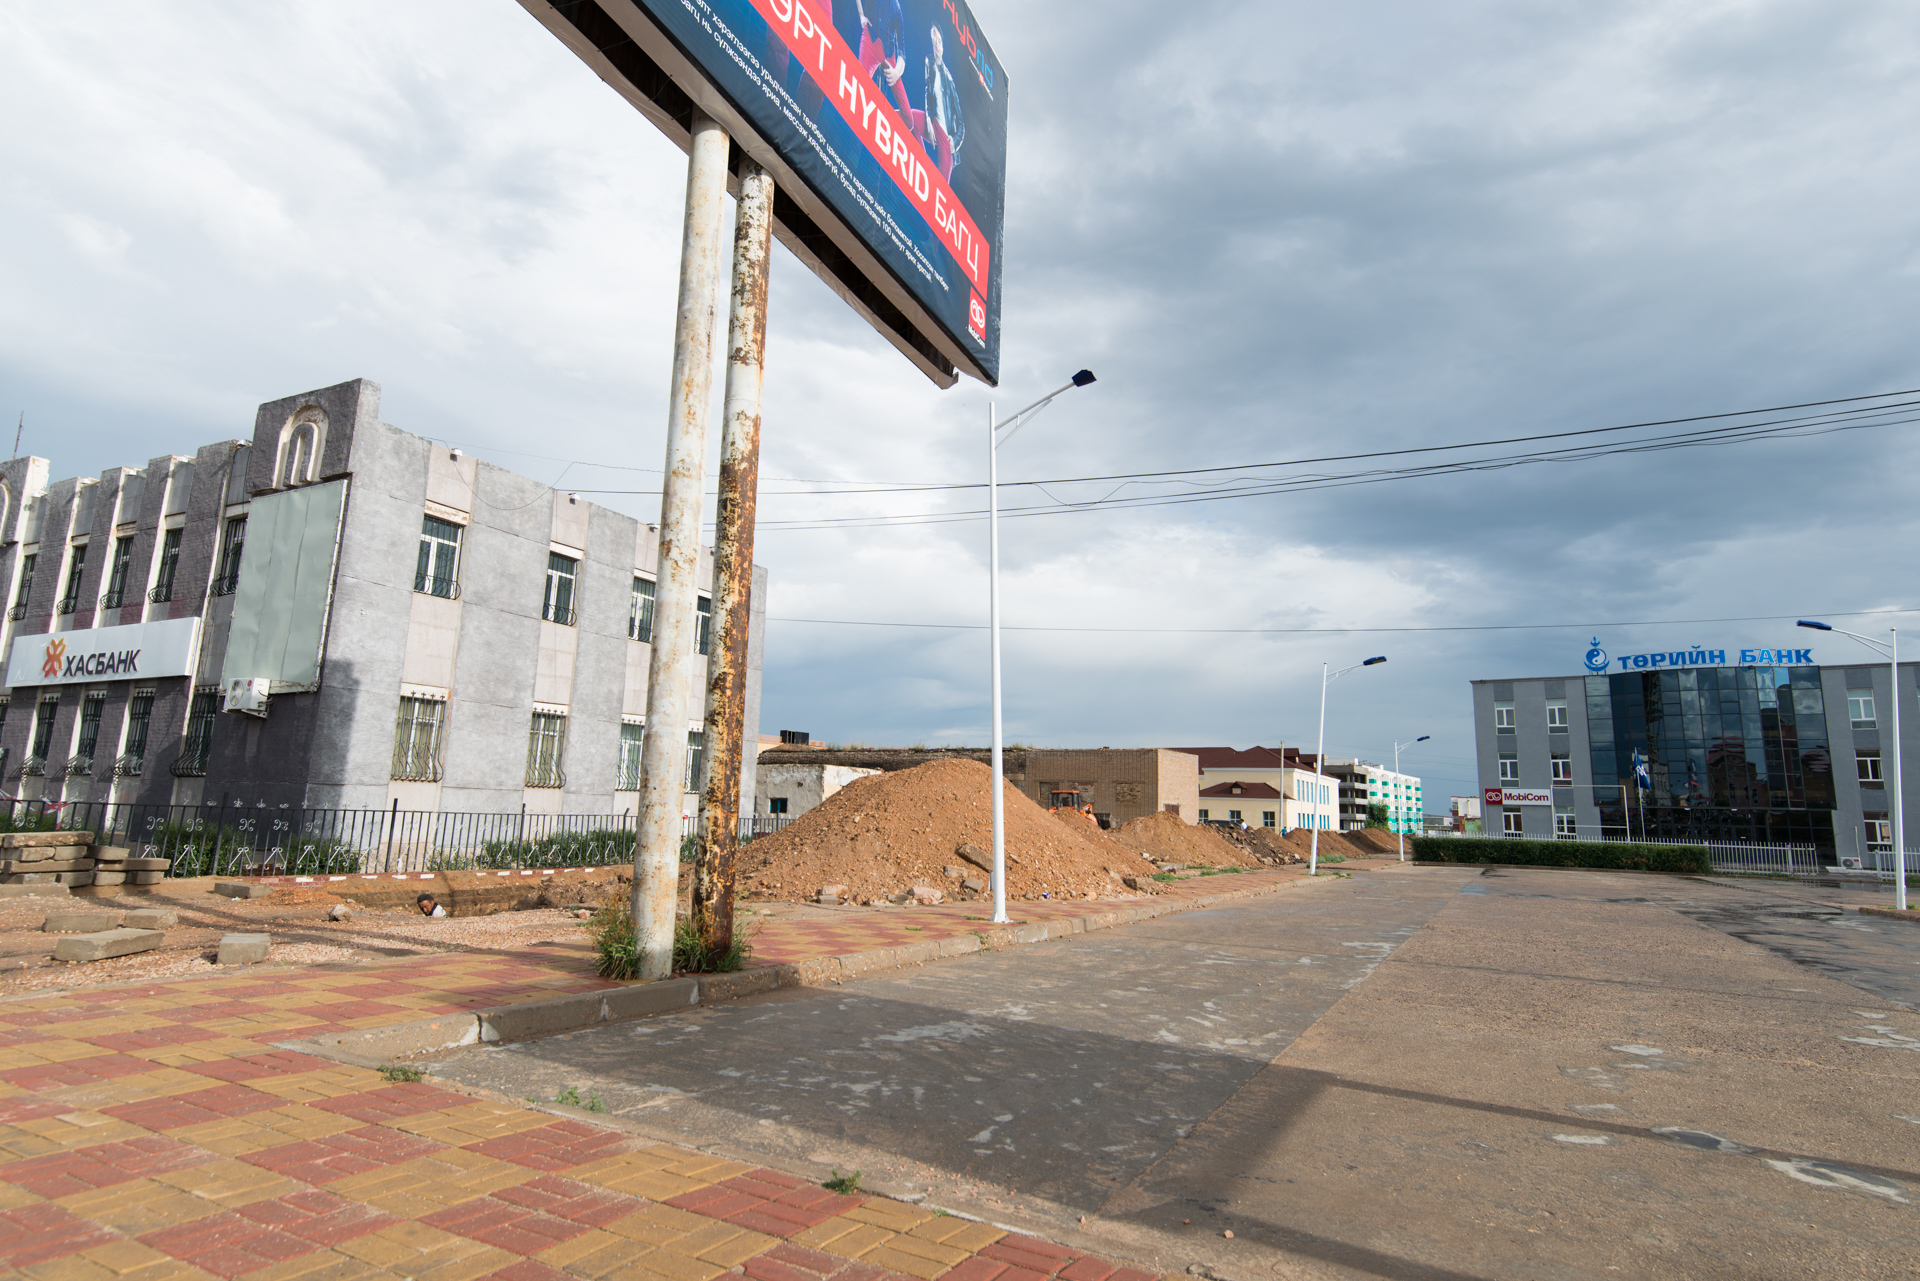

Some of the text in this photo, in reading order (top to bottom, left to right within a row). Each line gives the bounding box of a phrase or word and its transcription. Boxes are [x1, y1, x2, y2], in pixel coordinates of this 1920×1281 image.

[712, 13, 760, 68] хэрэглээгээ
[761, 66, 802, 116] урьдчилсан
[701, 18, 713, 34] нь
[714, 31, 761, 85] сүлжээндээ
[762, 83, 782, 110] яриа,
[882, 221, 892, 236] 100
[839, 59, 930, 202] HYBRID
[935, 188, 979, 282] БАГЦ
[63, 649, 141, 677] ХАСБАНК
[1617, 645, 1814, 670] ТӨРИЙН БАНК
[1504, 792, 1549, 802] MobiCom
